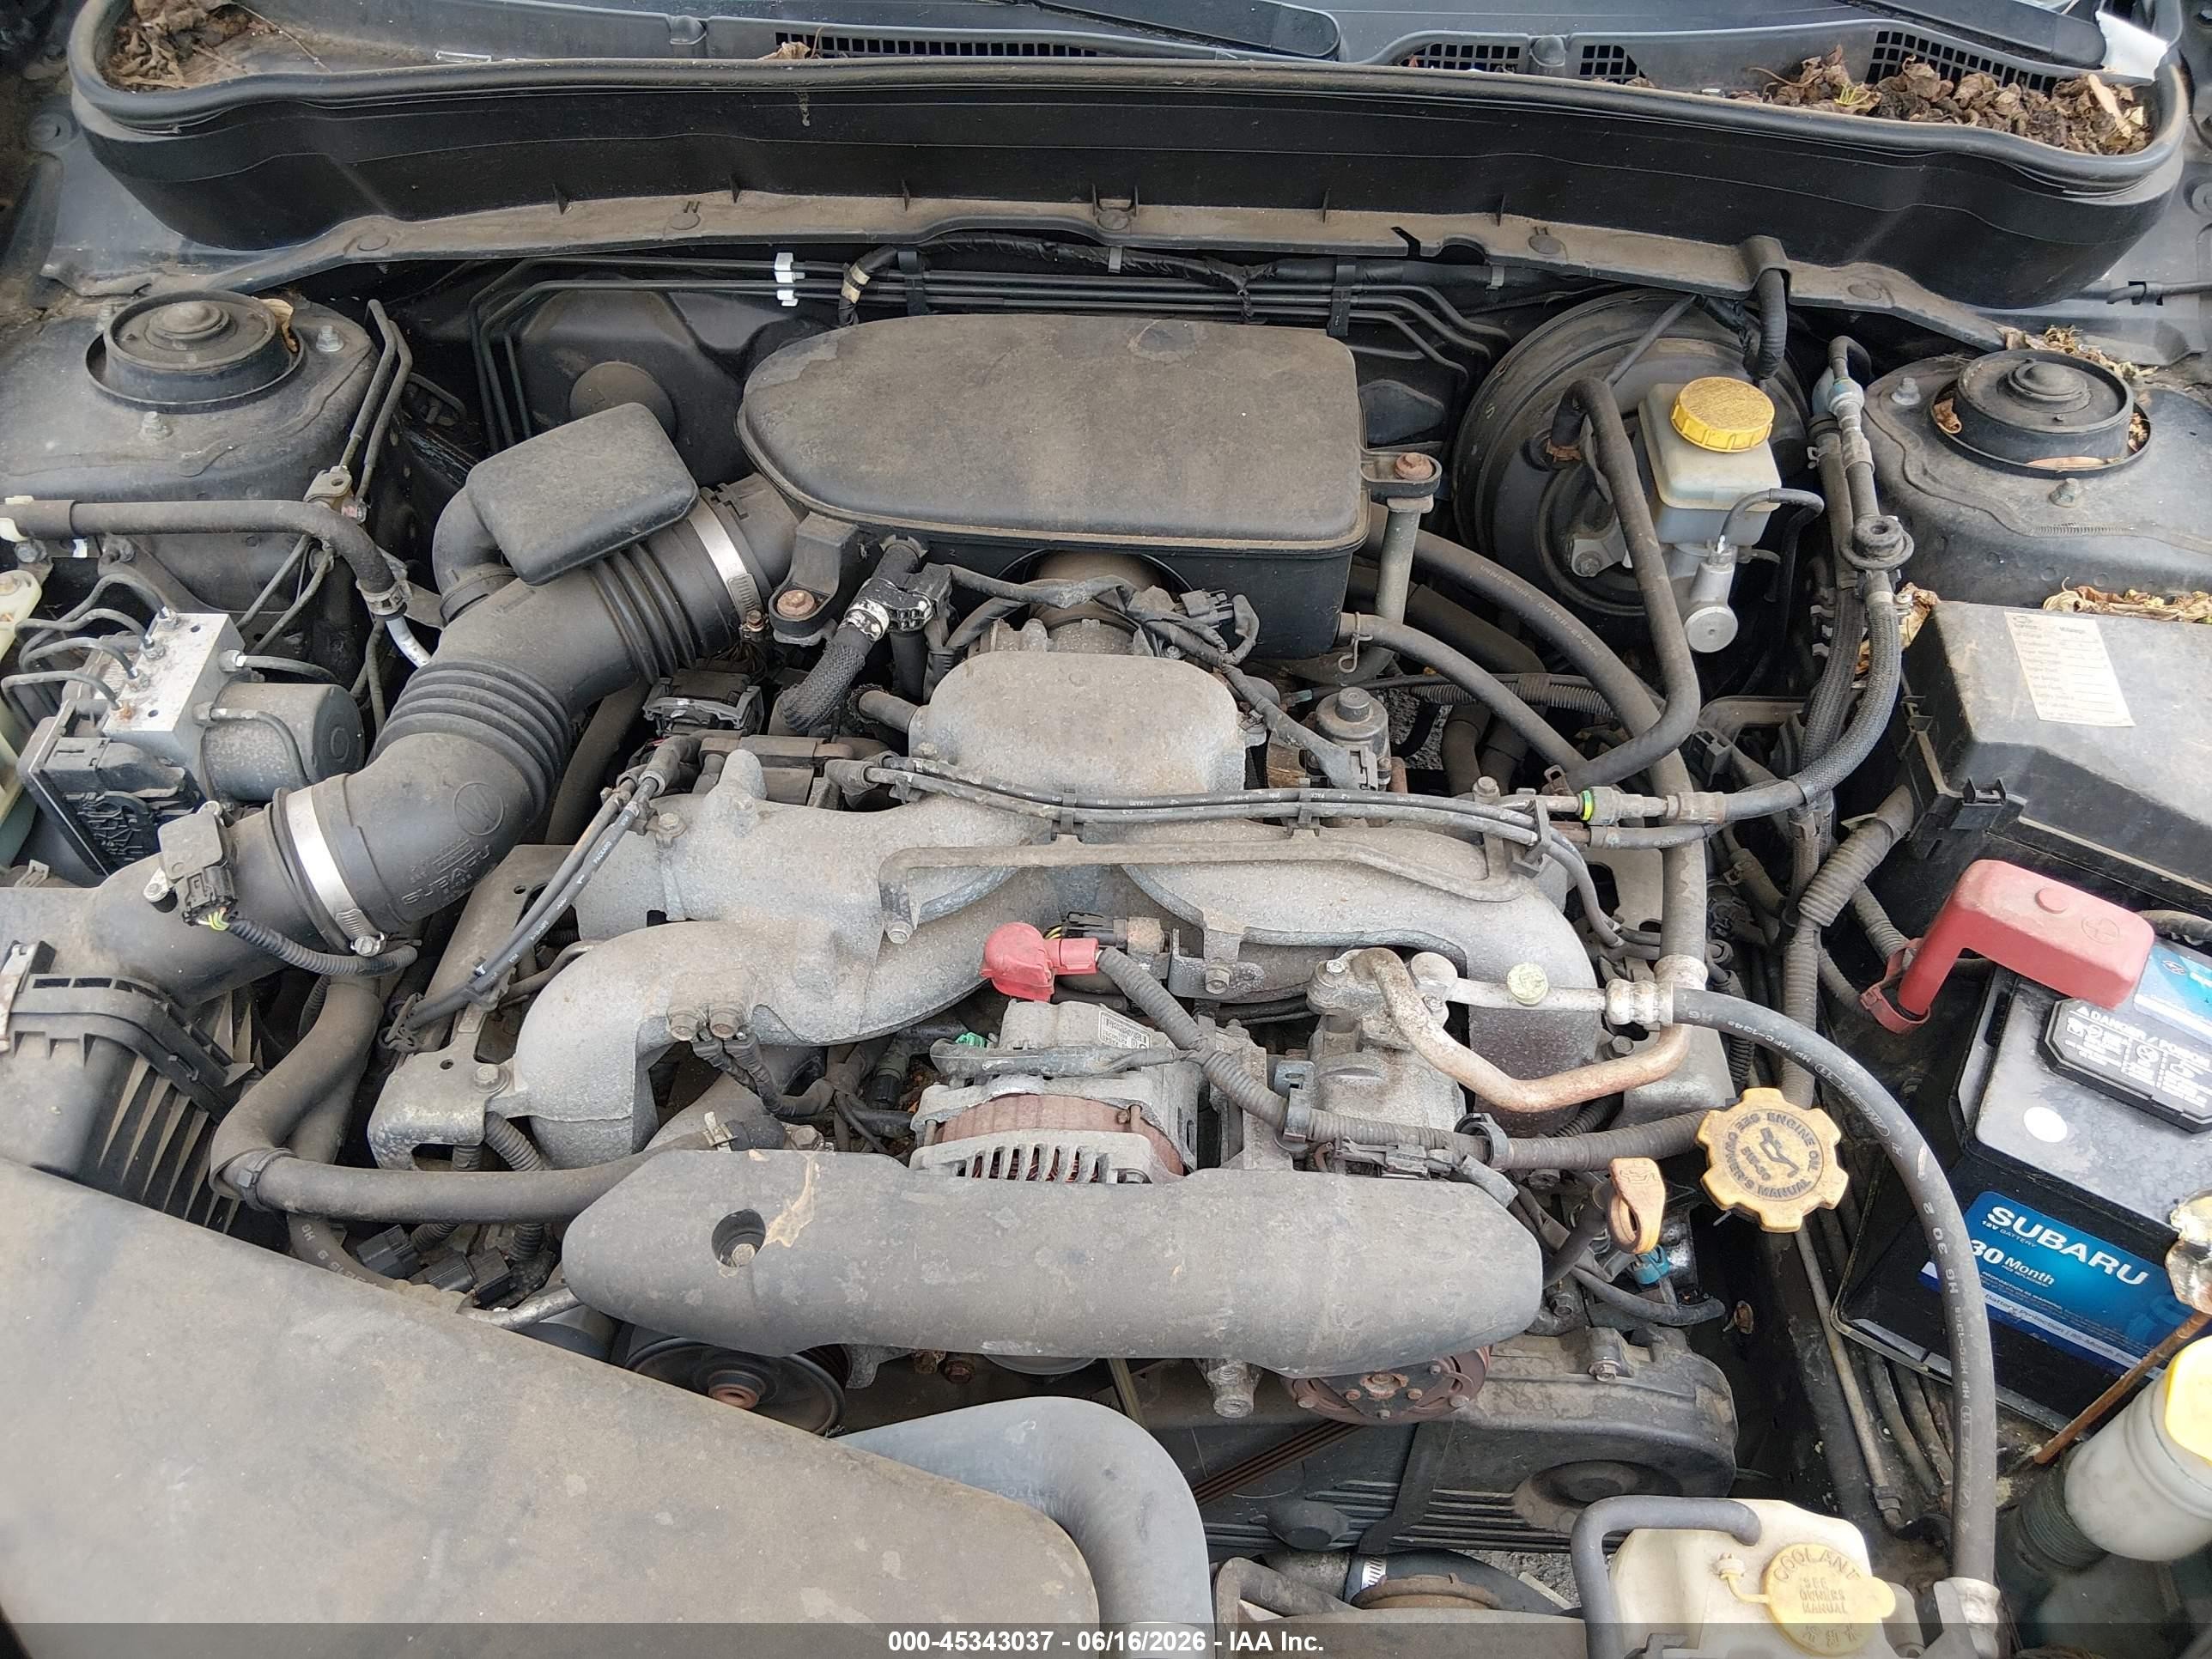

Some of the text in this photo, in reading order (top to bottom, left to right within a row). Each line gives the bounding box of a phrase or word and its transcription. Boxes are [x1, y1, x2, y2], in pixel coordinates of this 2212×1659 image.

[1735, 1113, 1760, 1133] SEE
[1757, 1178, 1812, 1199] MANUAL
[1766, 1112, 1822, 1172] ENGINE OIL
[1986, 1206, 2149, 1286] SUBARU
[1999, 1228, 2038, 1249] BATTERY
[2004, 1256, 2055, 1286] Month
[1774, 1549, 1861, 1582] COOLANT
[1802, 1601, 1848, 1614] MANUAL
